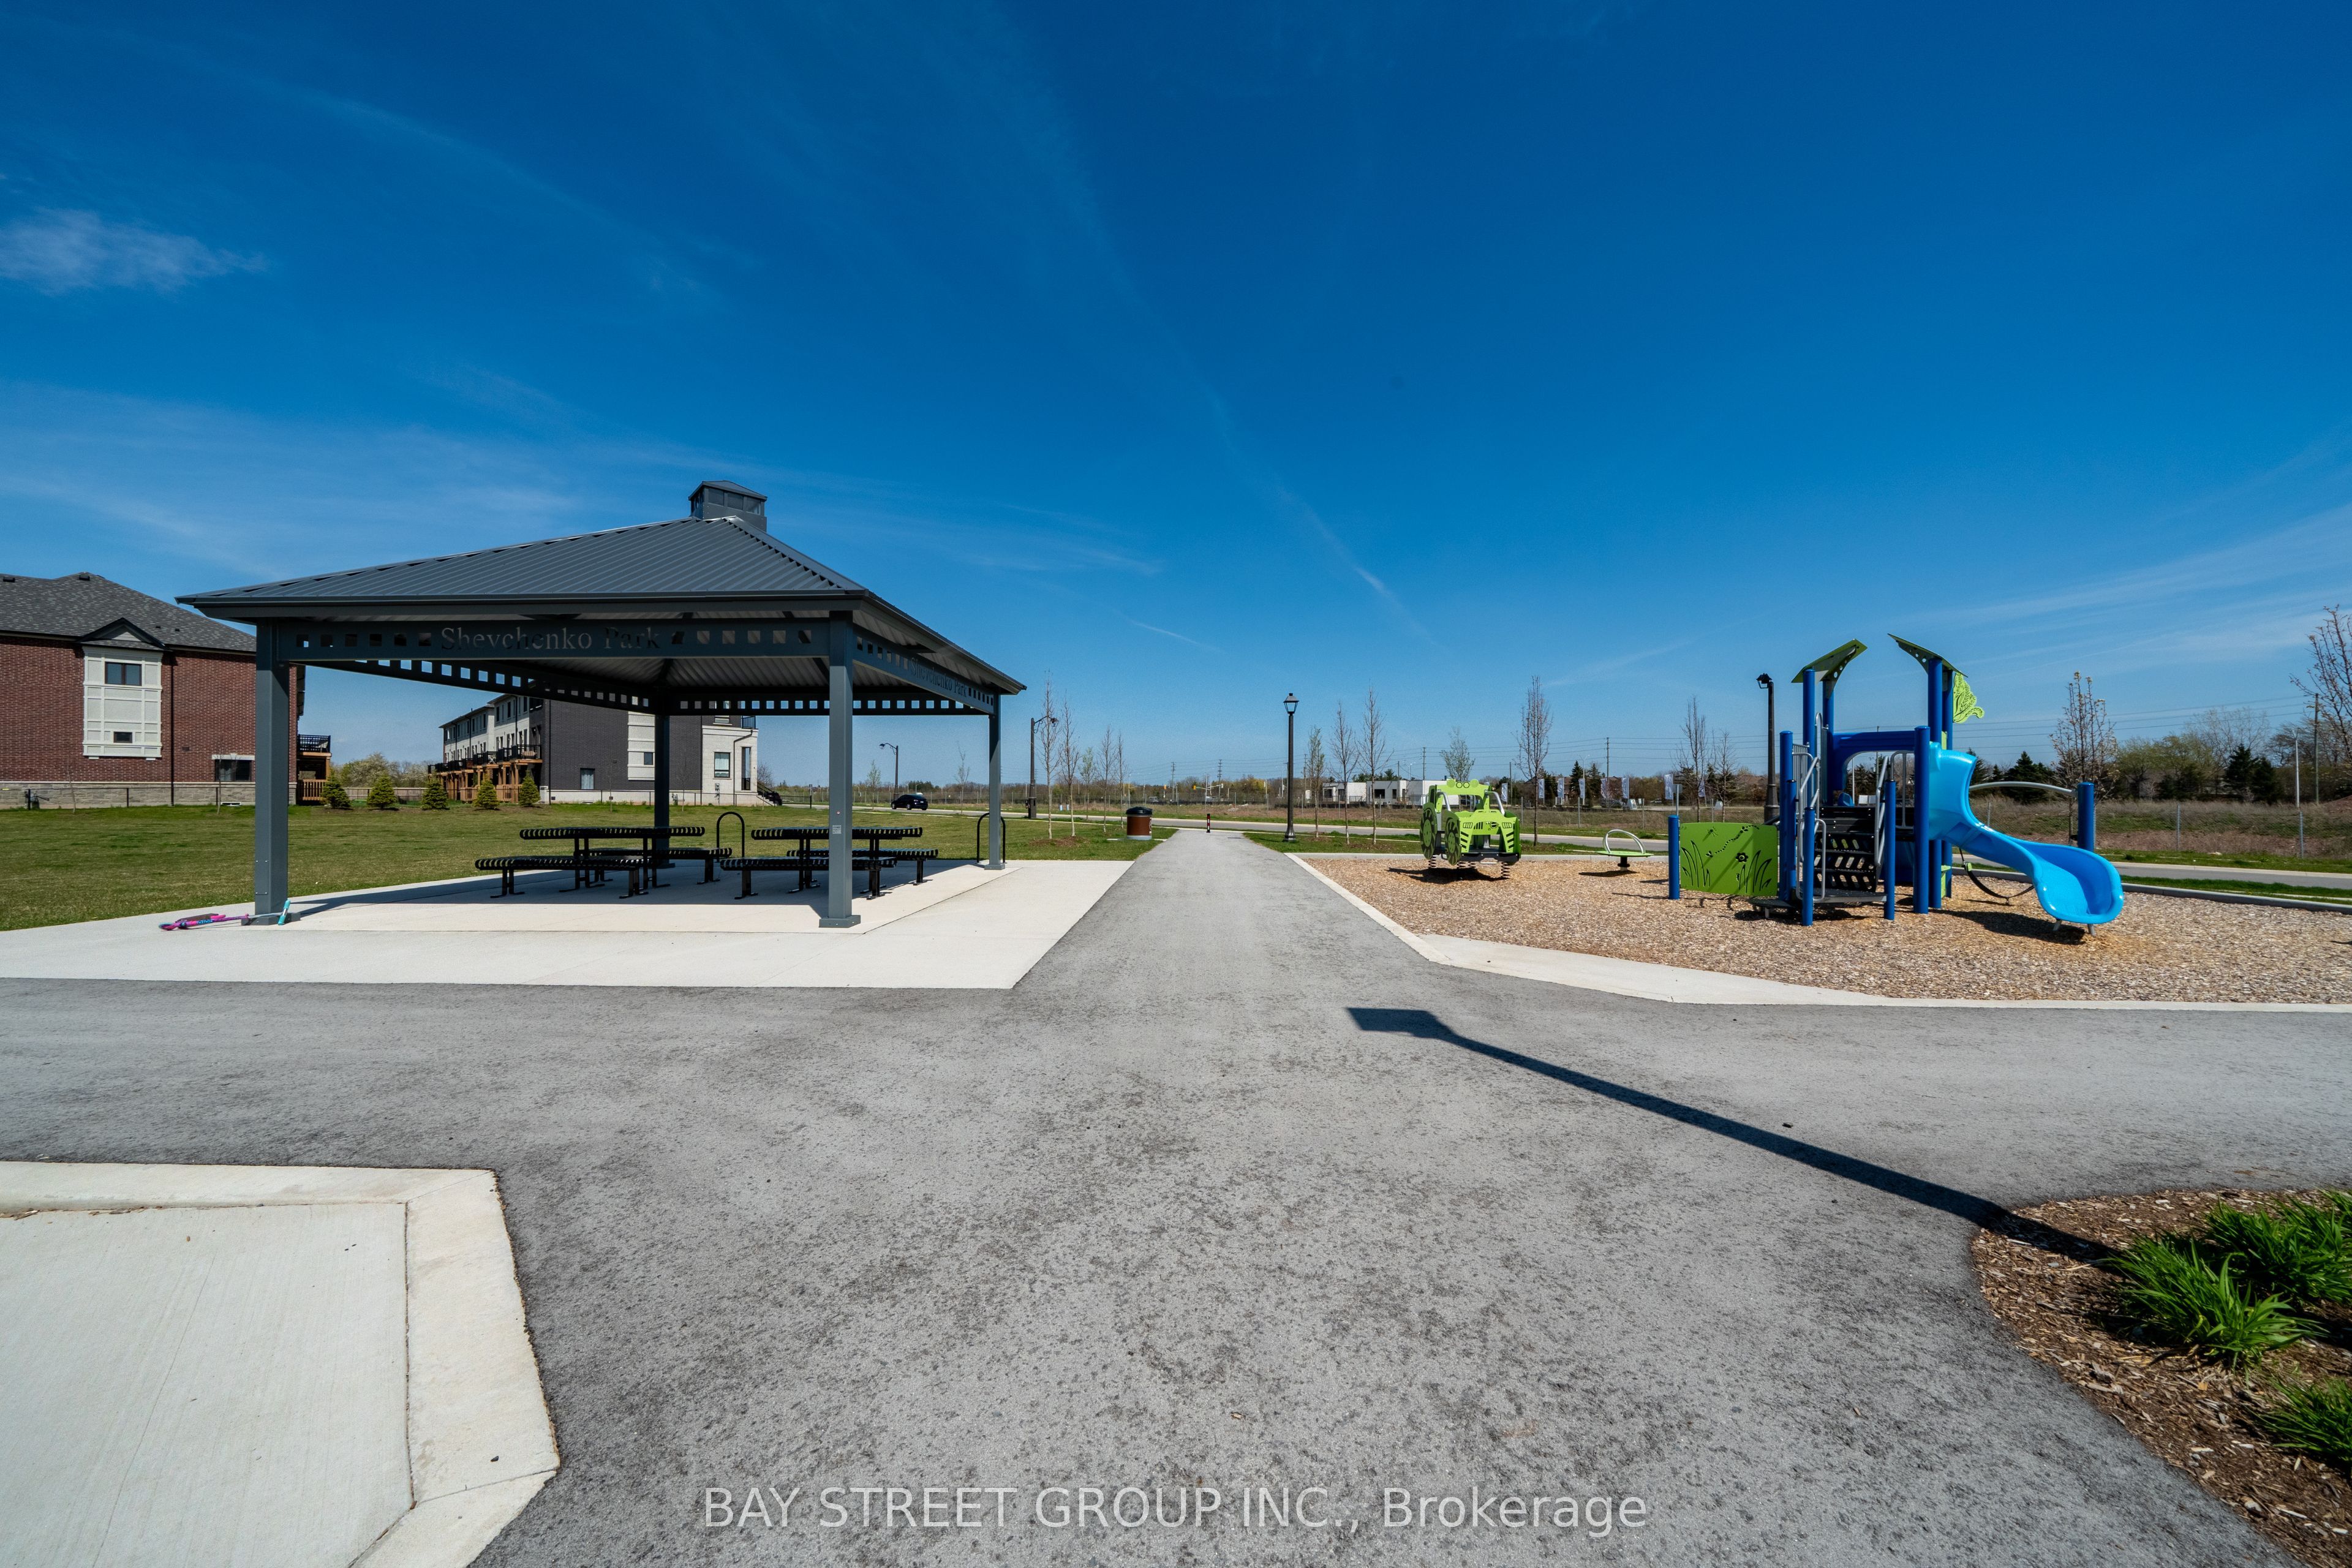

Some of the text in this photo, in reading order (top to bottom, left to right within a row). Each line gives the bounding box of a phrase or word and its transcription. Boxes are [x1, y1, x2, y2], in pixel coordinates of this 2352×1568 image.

[441, 627, 660, 650] Shevchenko Park
[911, 657, 967, 697] Shevchenko Park
